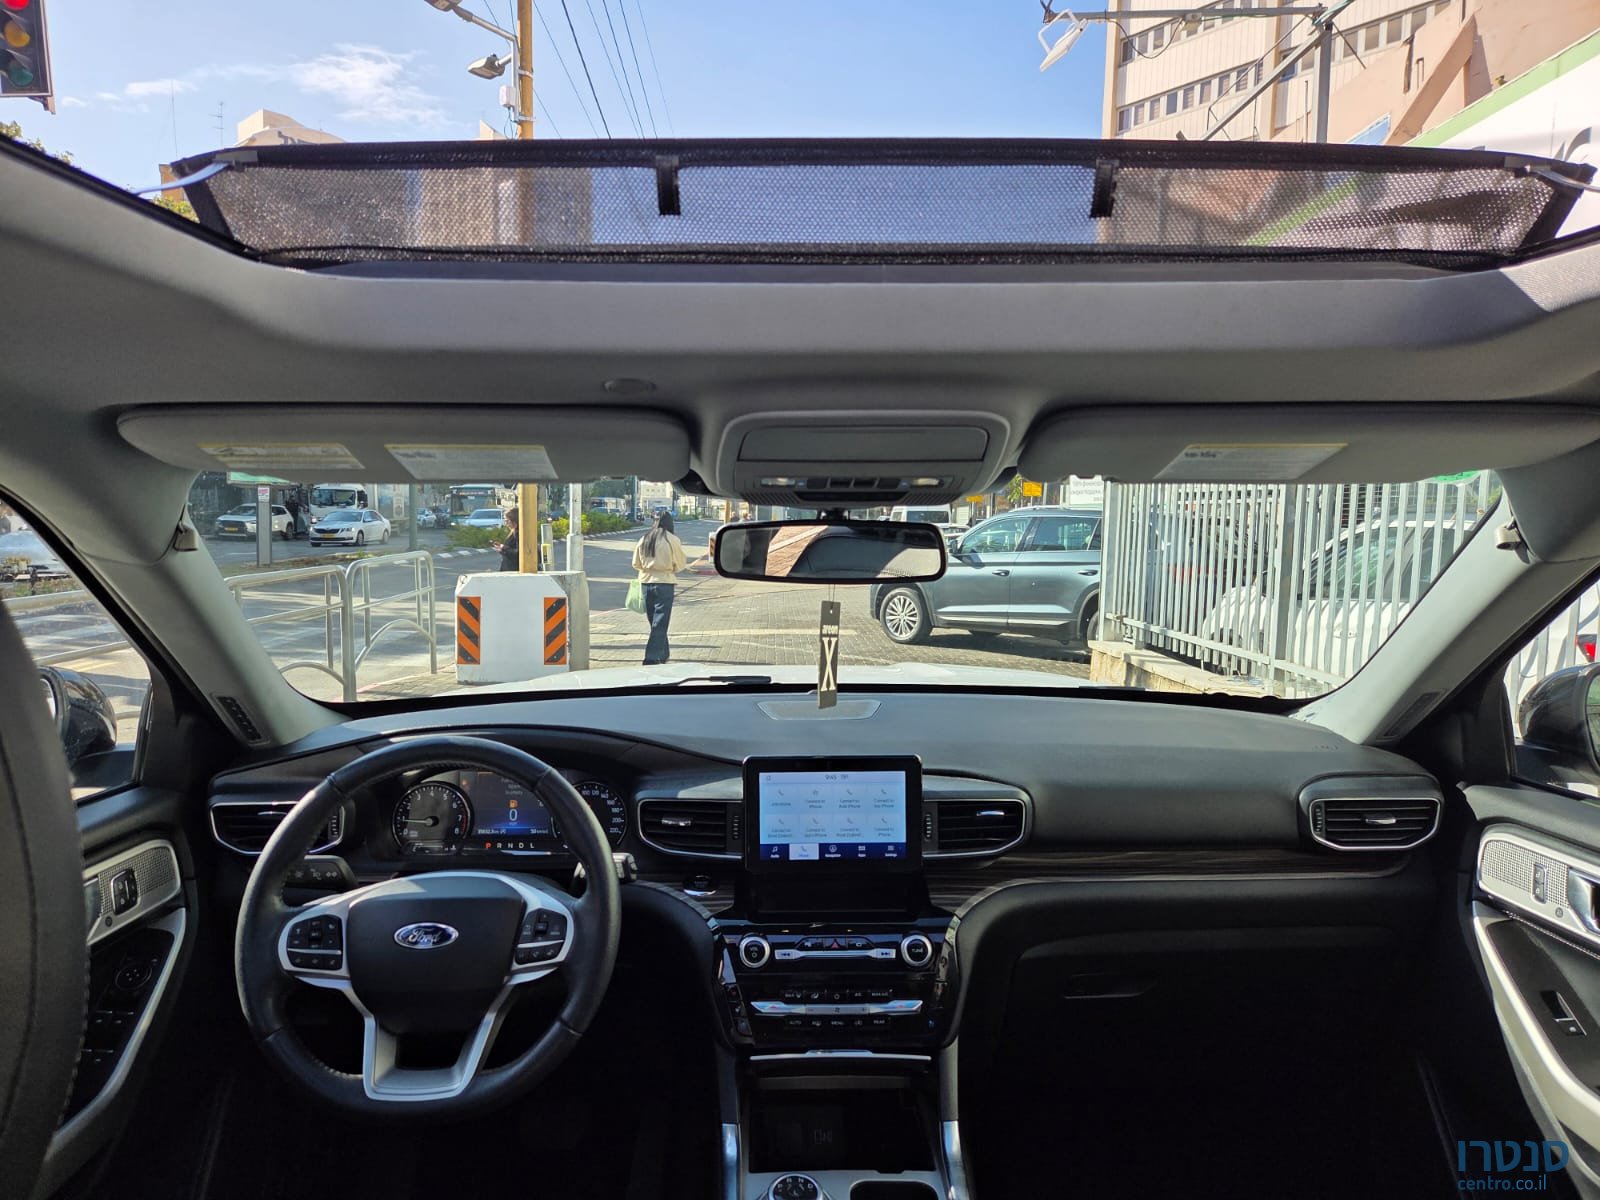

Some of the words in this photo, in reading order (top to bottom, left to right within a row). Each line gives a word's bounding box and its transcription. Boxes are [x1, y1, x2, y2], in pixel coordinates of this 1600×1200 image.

[821, 637, 838, 691] X
[509, 808, 518, 821] 0
[408, 927, 442, 943] Ford
